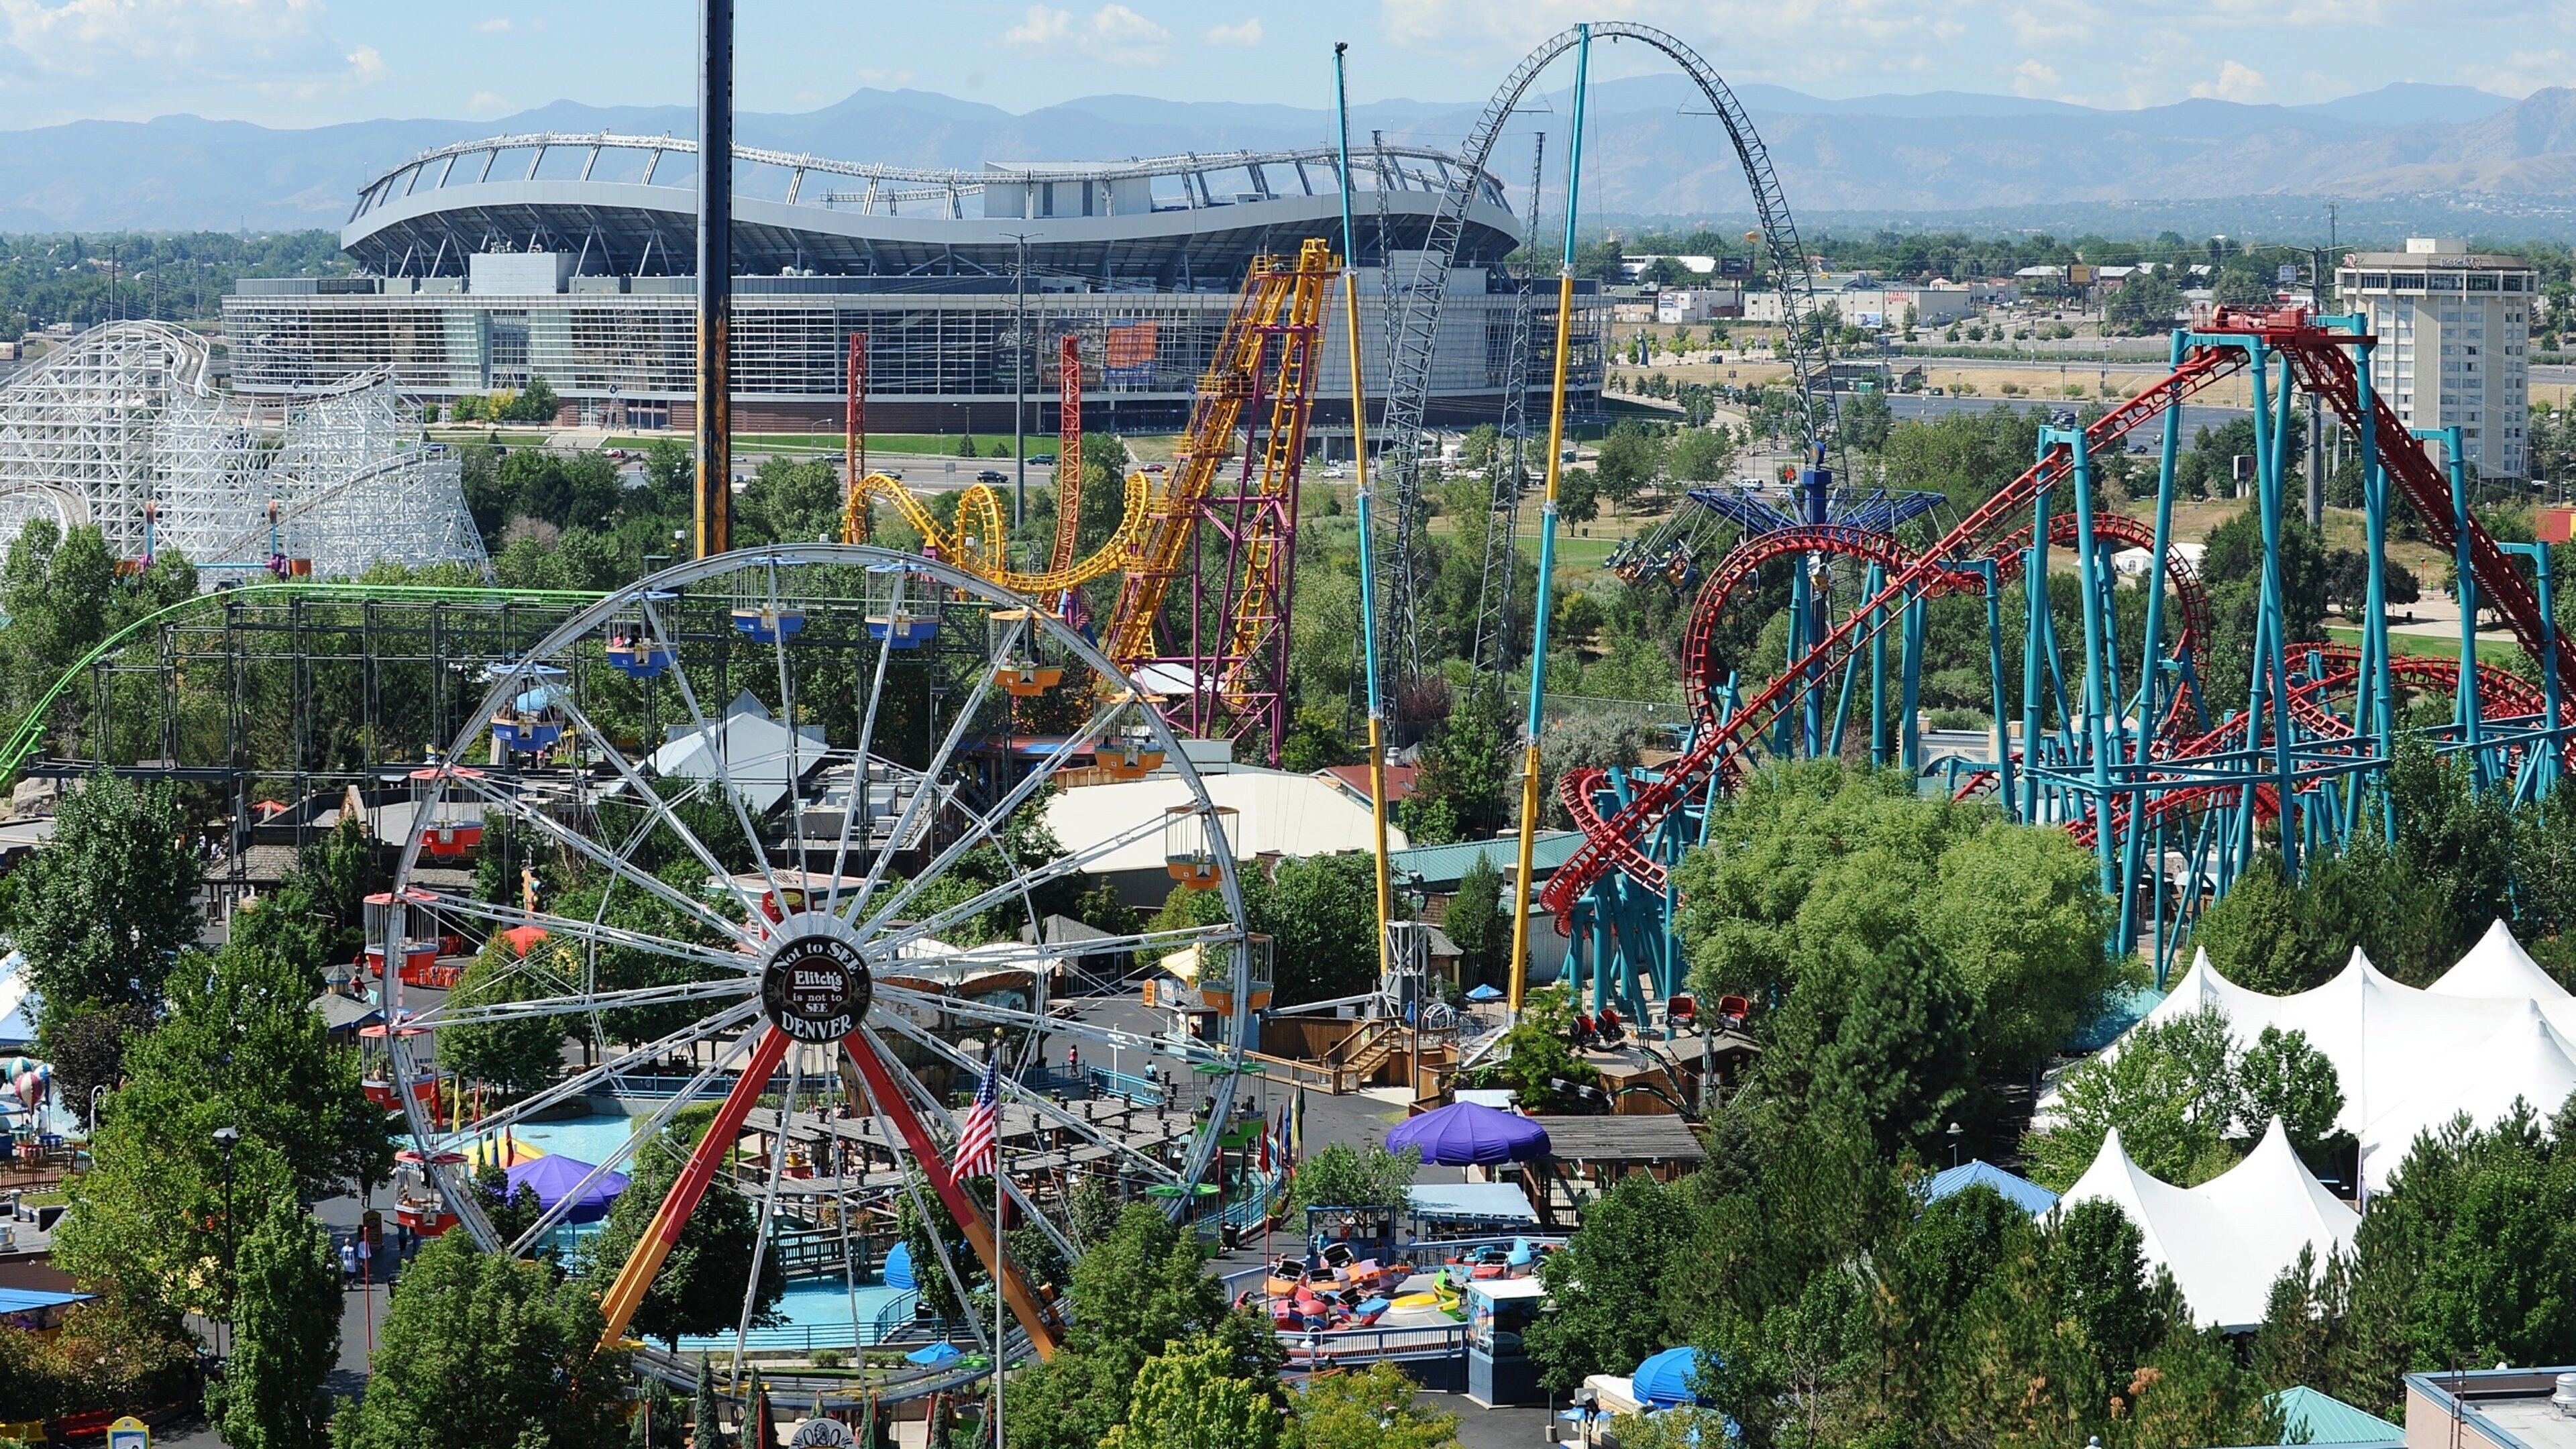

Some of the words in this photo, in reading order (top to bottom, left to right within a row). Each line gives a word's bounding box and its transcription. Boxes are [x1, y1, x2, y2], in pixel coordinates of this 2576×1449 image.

[772, 947, 802, 974] Not
[806, 942, 823, 954] to
[826, 941, 863, 975] SEE
[794, 970, 843, 991] Elitch's
[793, 994, 803, 1002] is
[808, 994, 826, 1002] not
[831, 994, 843, 1002] to
[805, 1003, 828, 1013] SEE
[782, 1011, 852, 1040] DENVER
